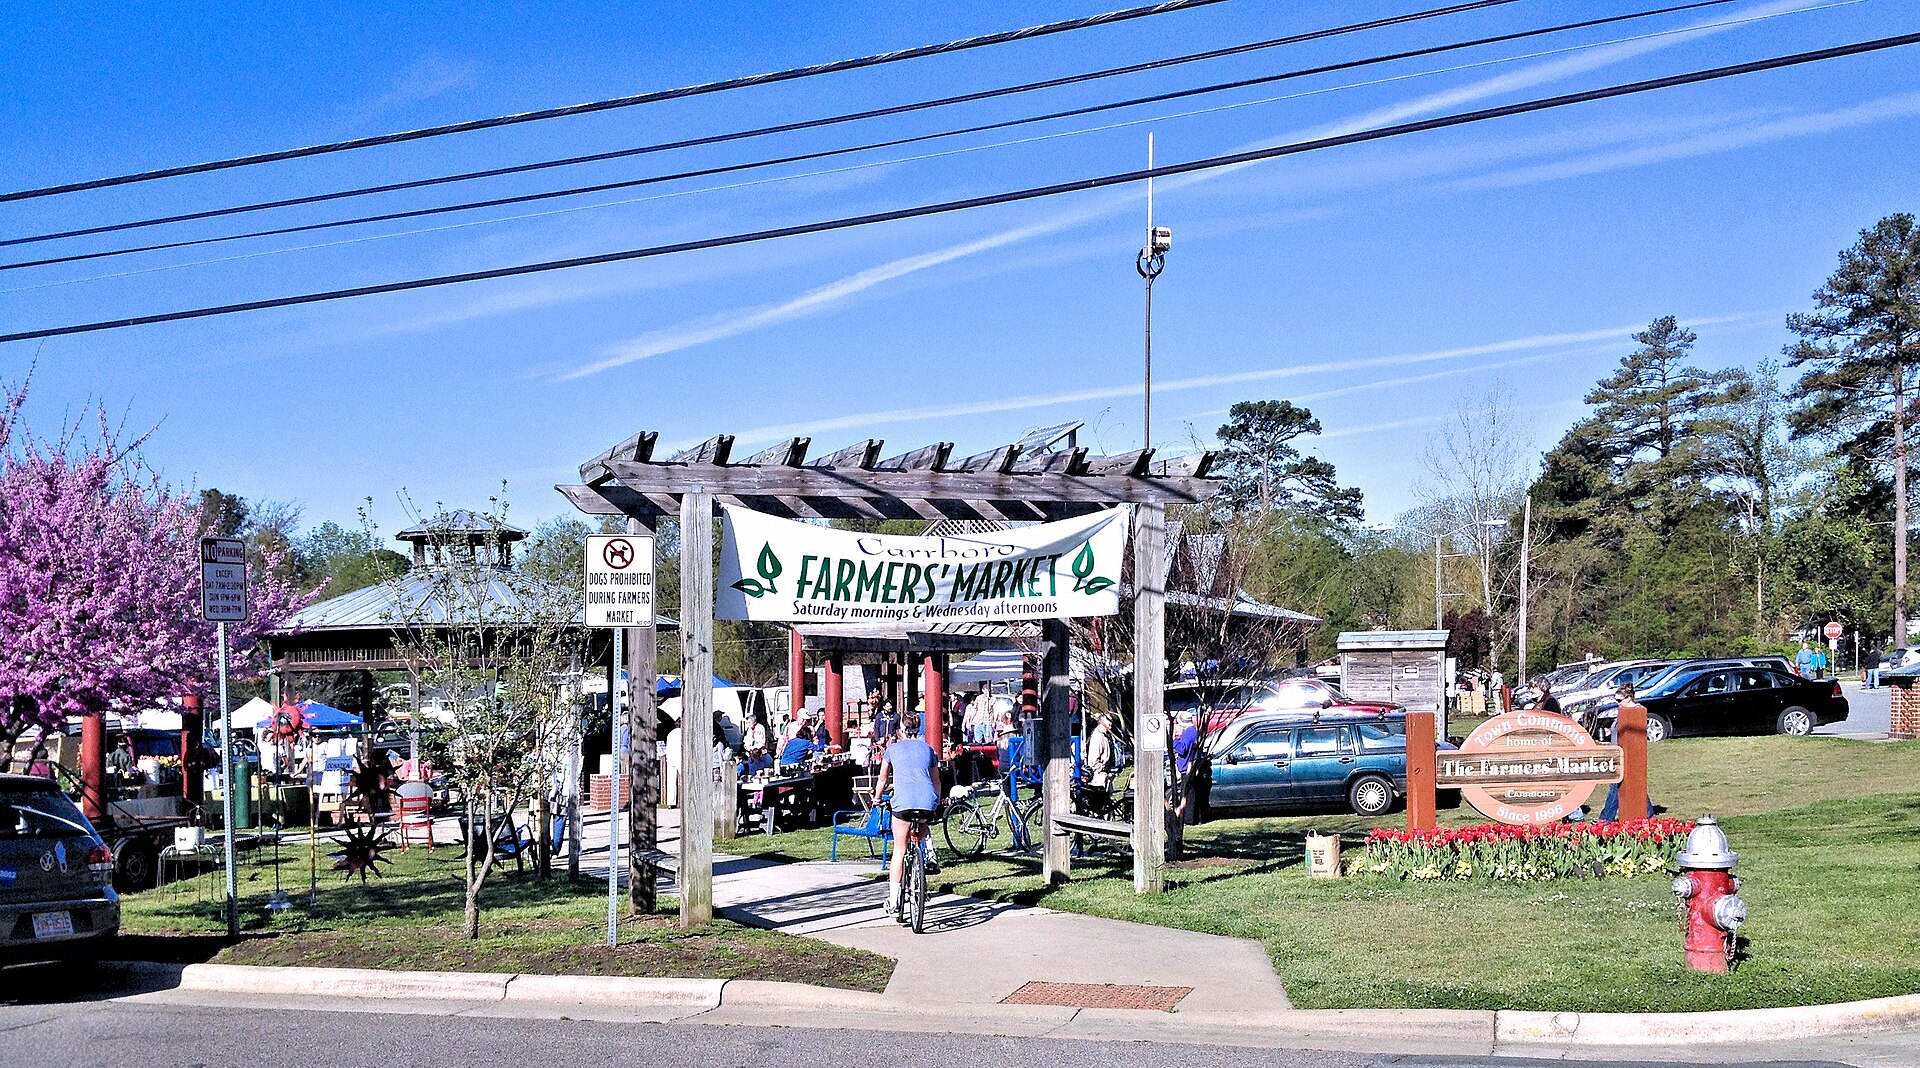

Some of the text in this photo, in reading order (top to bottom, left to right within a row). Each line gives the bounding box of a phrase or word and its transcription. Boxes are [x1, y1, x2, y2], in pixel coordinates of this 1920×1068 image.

[203, 544, 243, 560] NO PARKING
[857, 537, 1015, 559] Carrboro
[215, 570, 233, 578] EXCEPT
[589, 572, 651, 585] DOGS PROHIBITED
[796, 553, 1063, 604] FARMERS' MARKET
[206, 581, 214, 589] SAT
[209, 593, 219, 601] SUN
[589, 591, 650, 604] DURING FARMERS
[209, 605, 219, 613] WED
[793, 600, 1058, 621] Saturday mornings & Wednesday afternoons
[606, 610, 633, 622] MARKET
[1825, 626, 1841, 634] STOP
[1475, 712, 1587, 747] Town Commons
[1506, 734, 1553, 748] home of
[1442, 756, 1617, 777] The Farmers' Market
[1496, 804, 1564, 822] Since 1996
